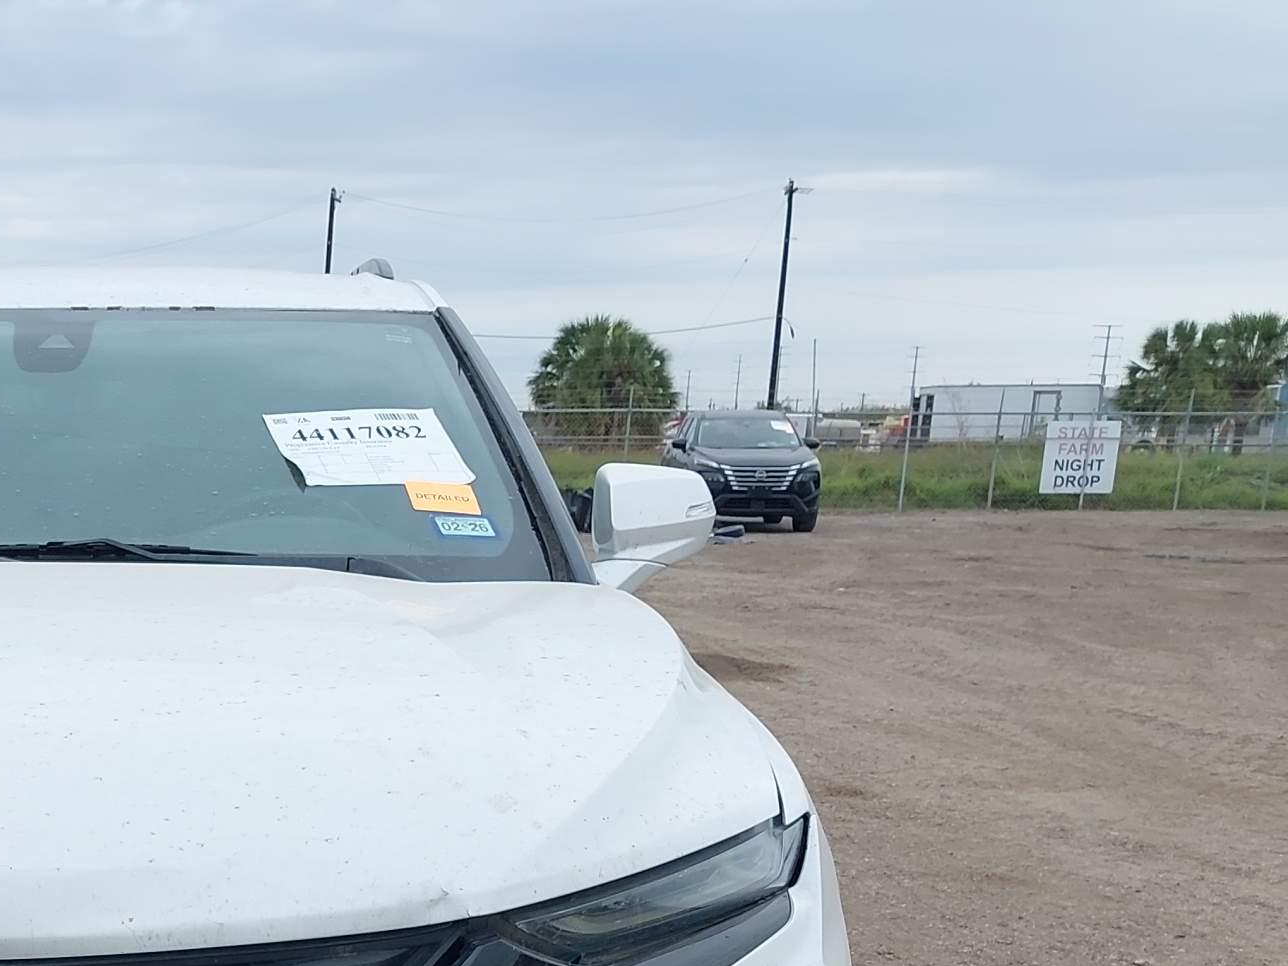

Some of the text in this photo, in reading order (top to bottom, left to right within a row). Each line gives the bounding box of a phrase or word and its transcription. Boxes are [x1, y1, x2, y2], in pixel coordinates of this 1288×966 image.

[292, 424, 427, 442] 44117082
[1058, 426, 1109, 440] STATE
[1058, 443, 1104, 456] FARM
[1053, 459, 1105, 472] NIGHT
[1053, 475, 1101, 489] DROP
[415, 492, 470, 503] DETAILED
[469, 522, 489, 533] 26
